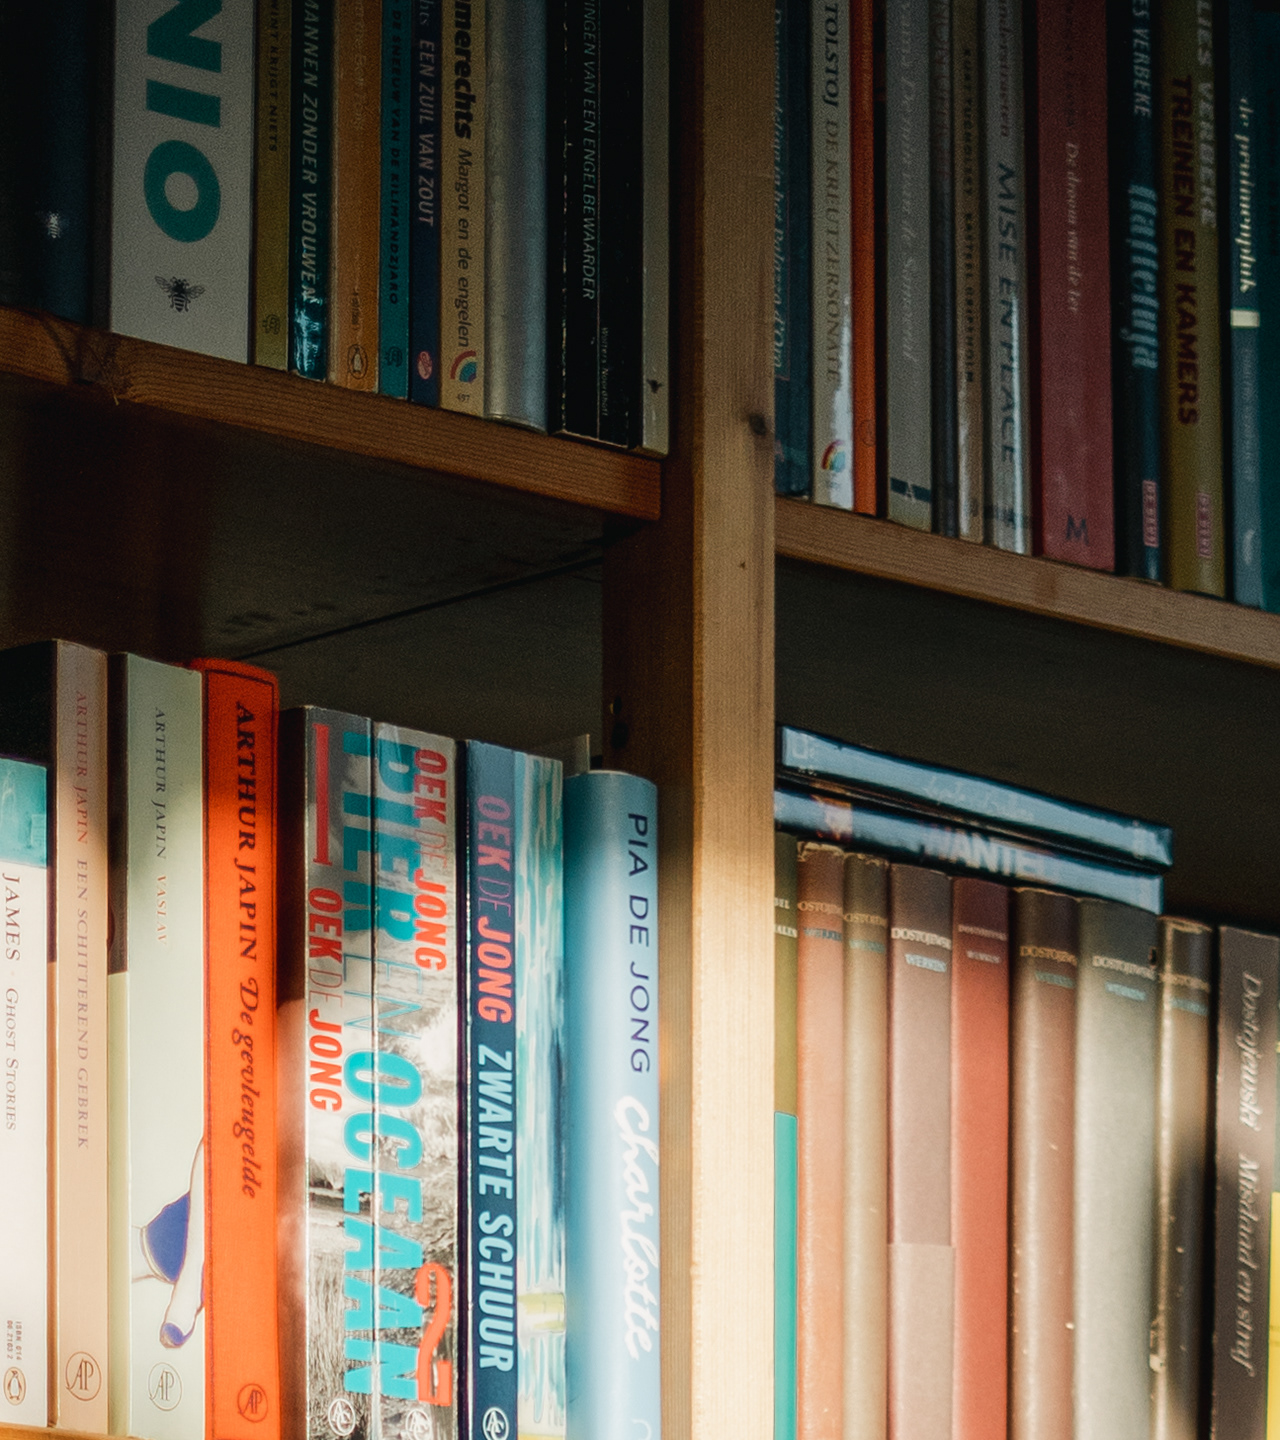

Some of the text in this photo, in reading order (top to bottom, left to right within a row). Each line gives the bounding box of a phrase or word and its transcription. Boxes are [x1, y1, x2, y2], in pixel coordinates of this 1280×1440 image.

[301, 93, 319, 305] ZONDER VROUWEN
[418, 39, 434, 226] EEN ZUIL VAN ZOUT
[581, 135, 596, 301] ENGELBEWAARDER
[454, 147, 472, 348] Margot en de engelen
[1170, 75, 1200, 426] TREINEN EN KAMERS
[3, 873, 21, 962] JAMES
[231, 702, 268, 1201] ARTHUR JAPIN De gevleugelde
[475, 795, 514, 1375] OEK DE JONG ZWARTE SCHUUR
[612, 812, 661, 1363] PIA DE JONG Charlotte
